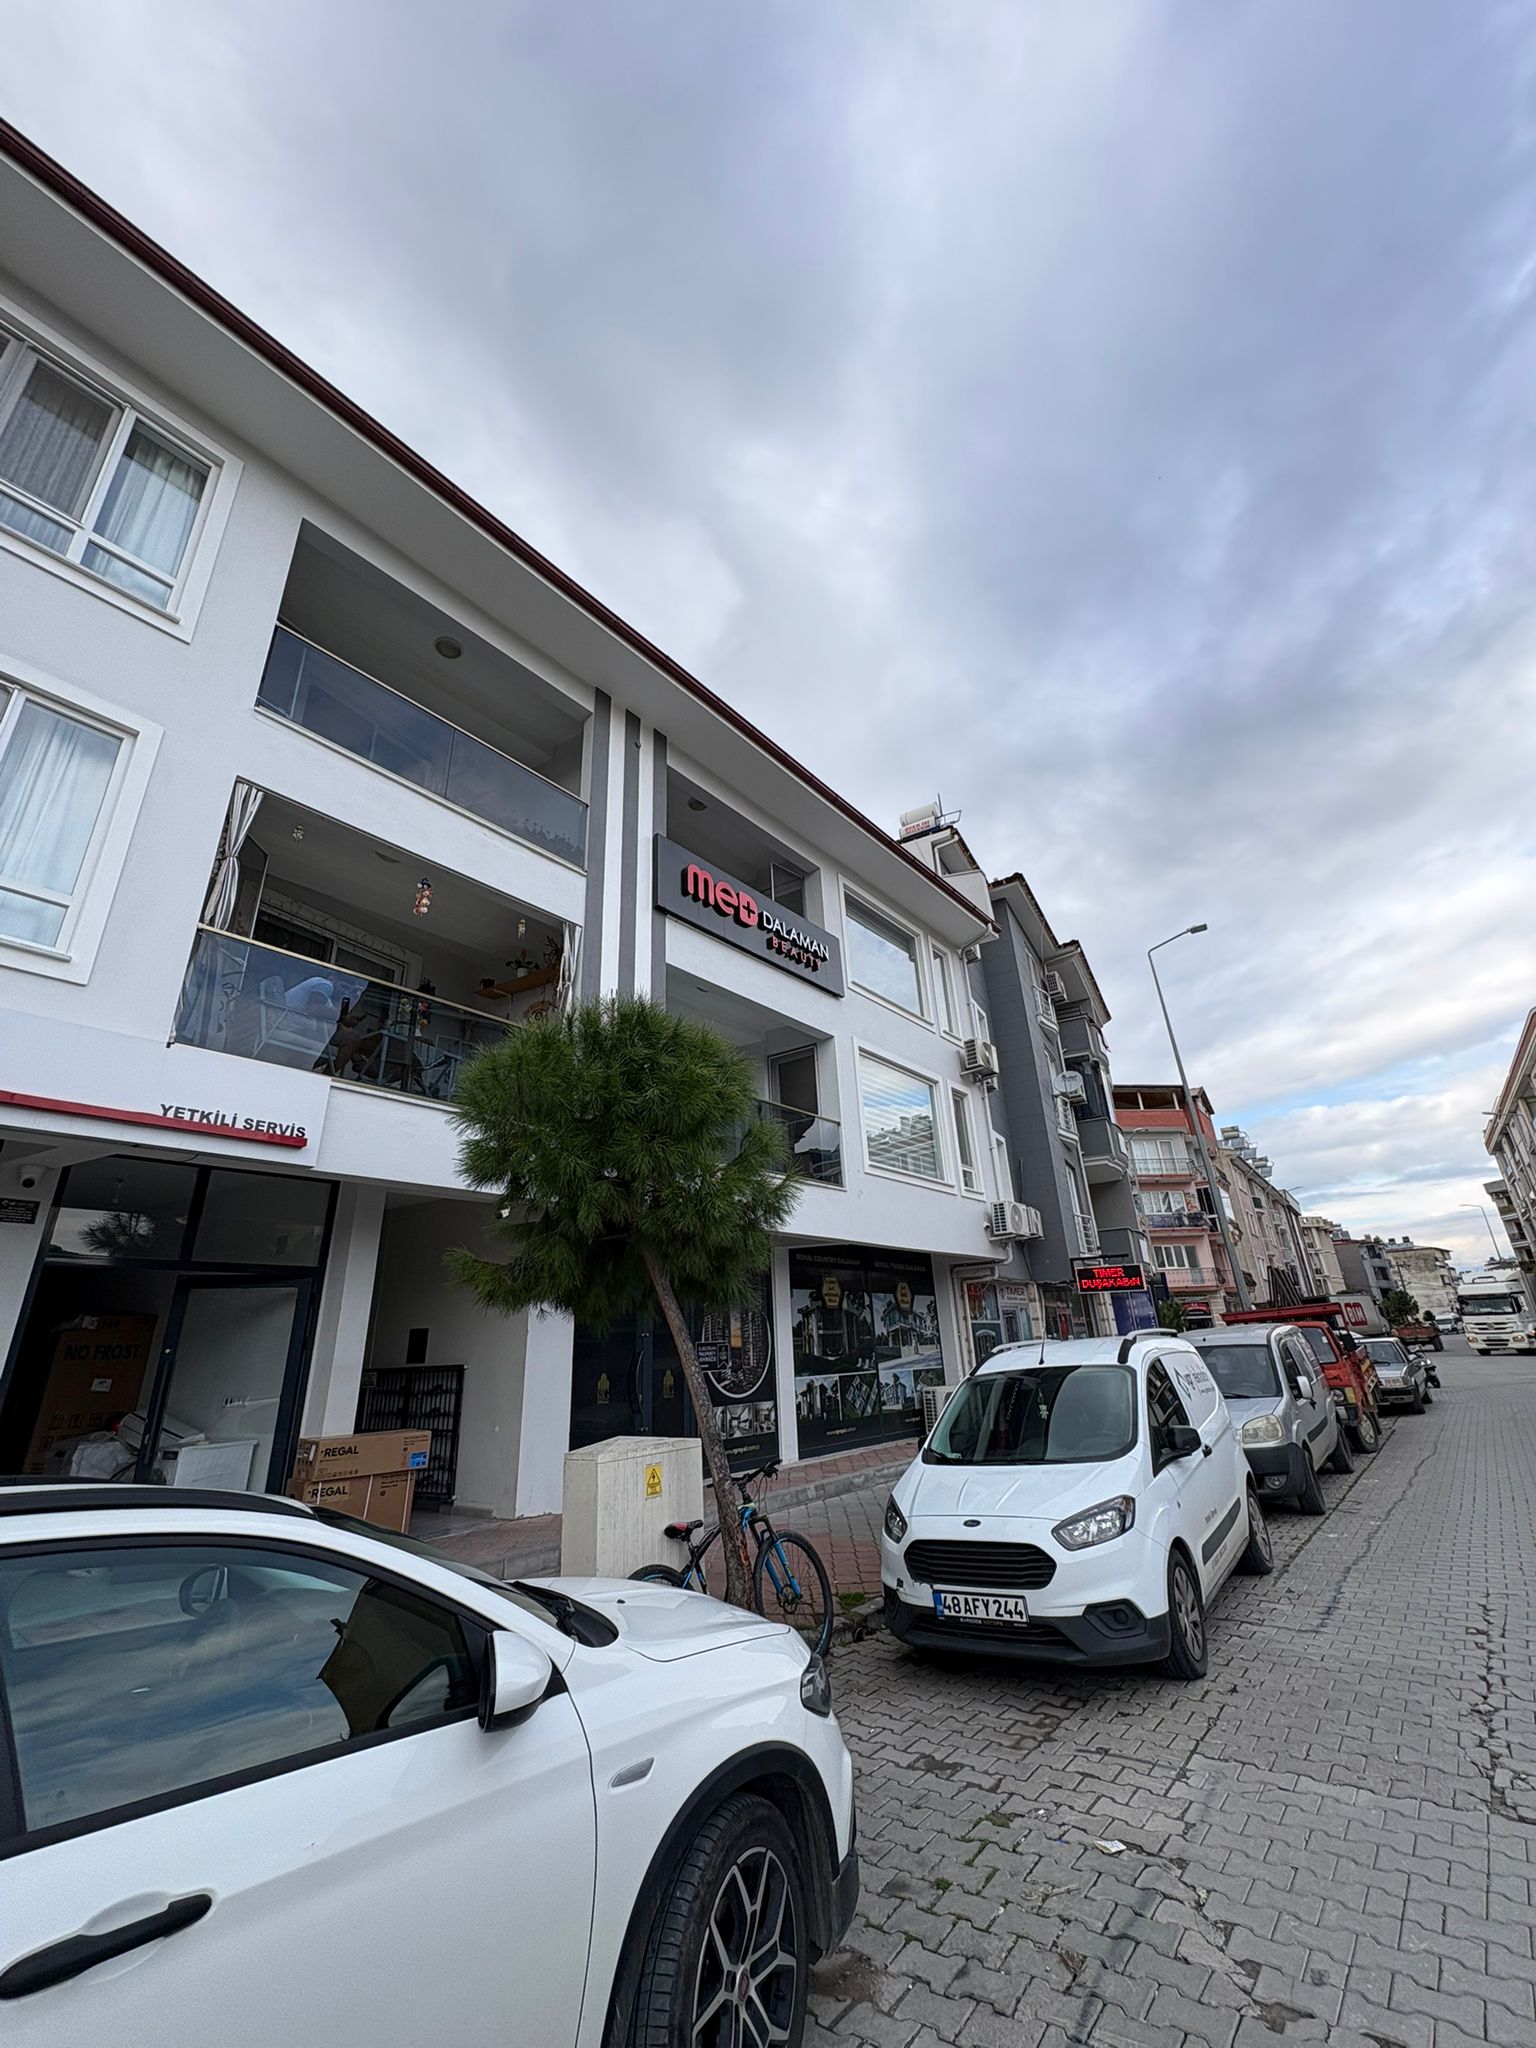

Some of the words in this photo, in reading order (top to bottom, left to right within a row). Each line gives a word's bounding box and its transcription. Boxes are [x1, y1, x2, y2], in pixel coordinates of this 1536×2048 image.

[762, 910, 830, 960] DALAMAN
[771, 935, 823, 970] BEAUTY
[160, 1103, 238, 1128] YETKİLİ
[242, 1117, 307, 1138] SERVİS
[1092, 1267, 1125, 1278] TIMER
[1004, 1286, 1026, 1297] TIMER
[63, 1344, 90, 1361] NO
[94, 1344, 141, 1361] FROST
[323, 1445, 360, 1458] REGAL
[311, 1486, 349, 1498] REGAL
[943, 1595, 961, 1614] 48
[964, 1597, 990, 1617] AFY
[992, 1599, 1024, 1619] 244
